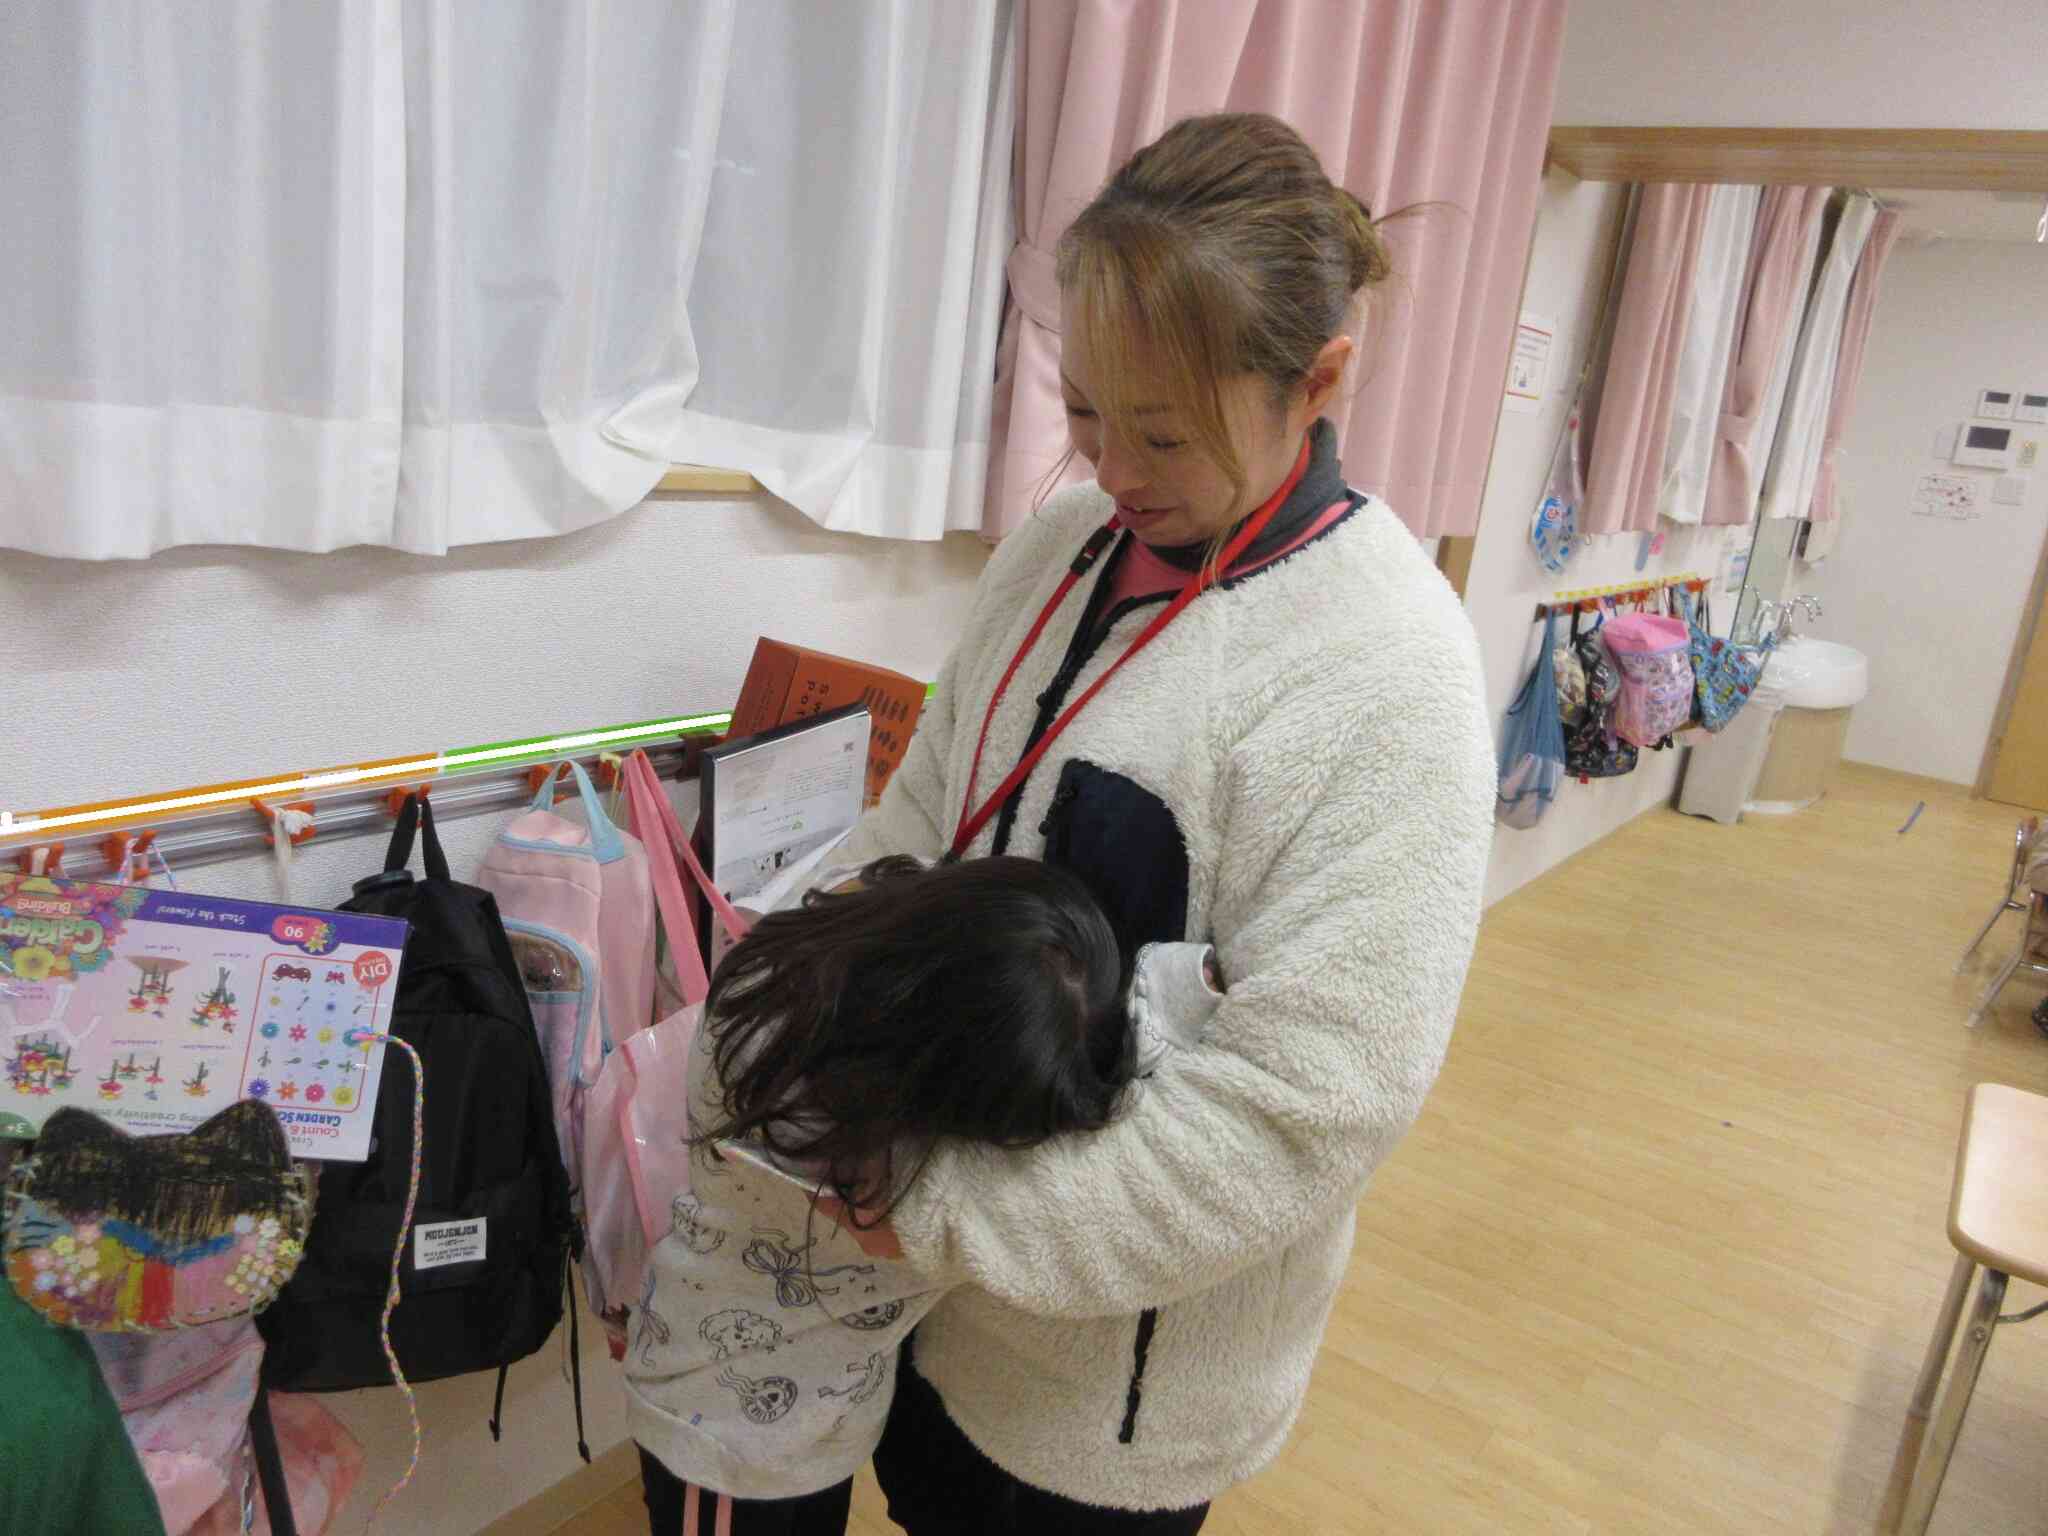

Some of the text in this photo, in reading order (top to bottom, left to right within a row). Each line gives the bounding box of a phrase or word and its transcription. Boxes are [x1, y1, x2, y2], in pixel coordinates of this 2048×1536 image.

[16, 898, 72, 915] Building
[284, 926, 304, 938] 90
[360, 962, 387, 980] DIY
[296, 1111, 341, 1126] GARDEN
[303, 1126, 339, 1138] Count
